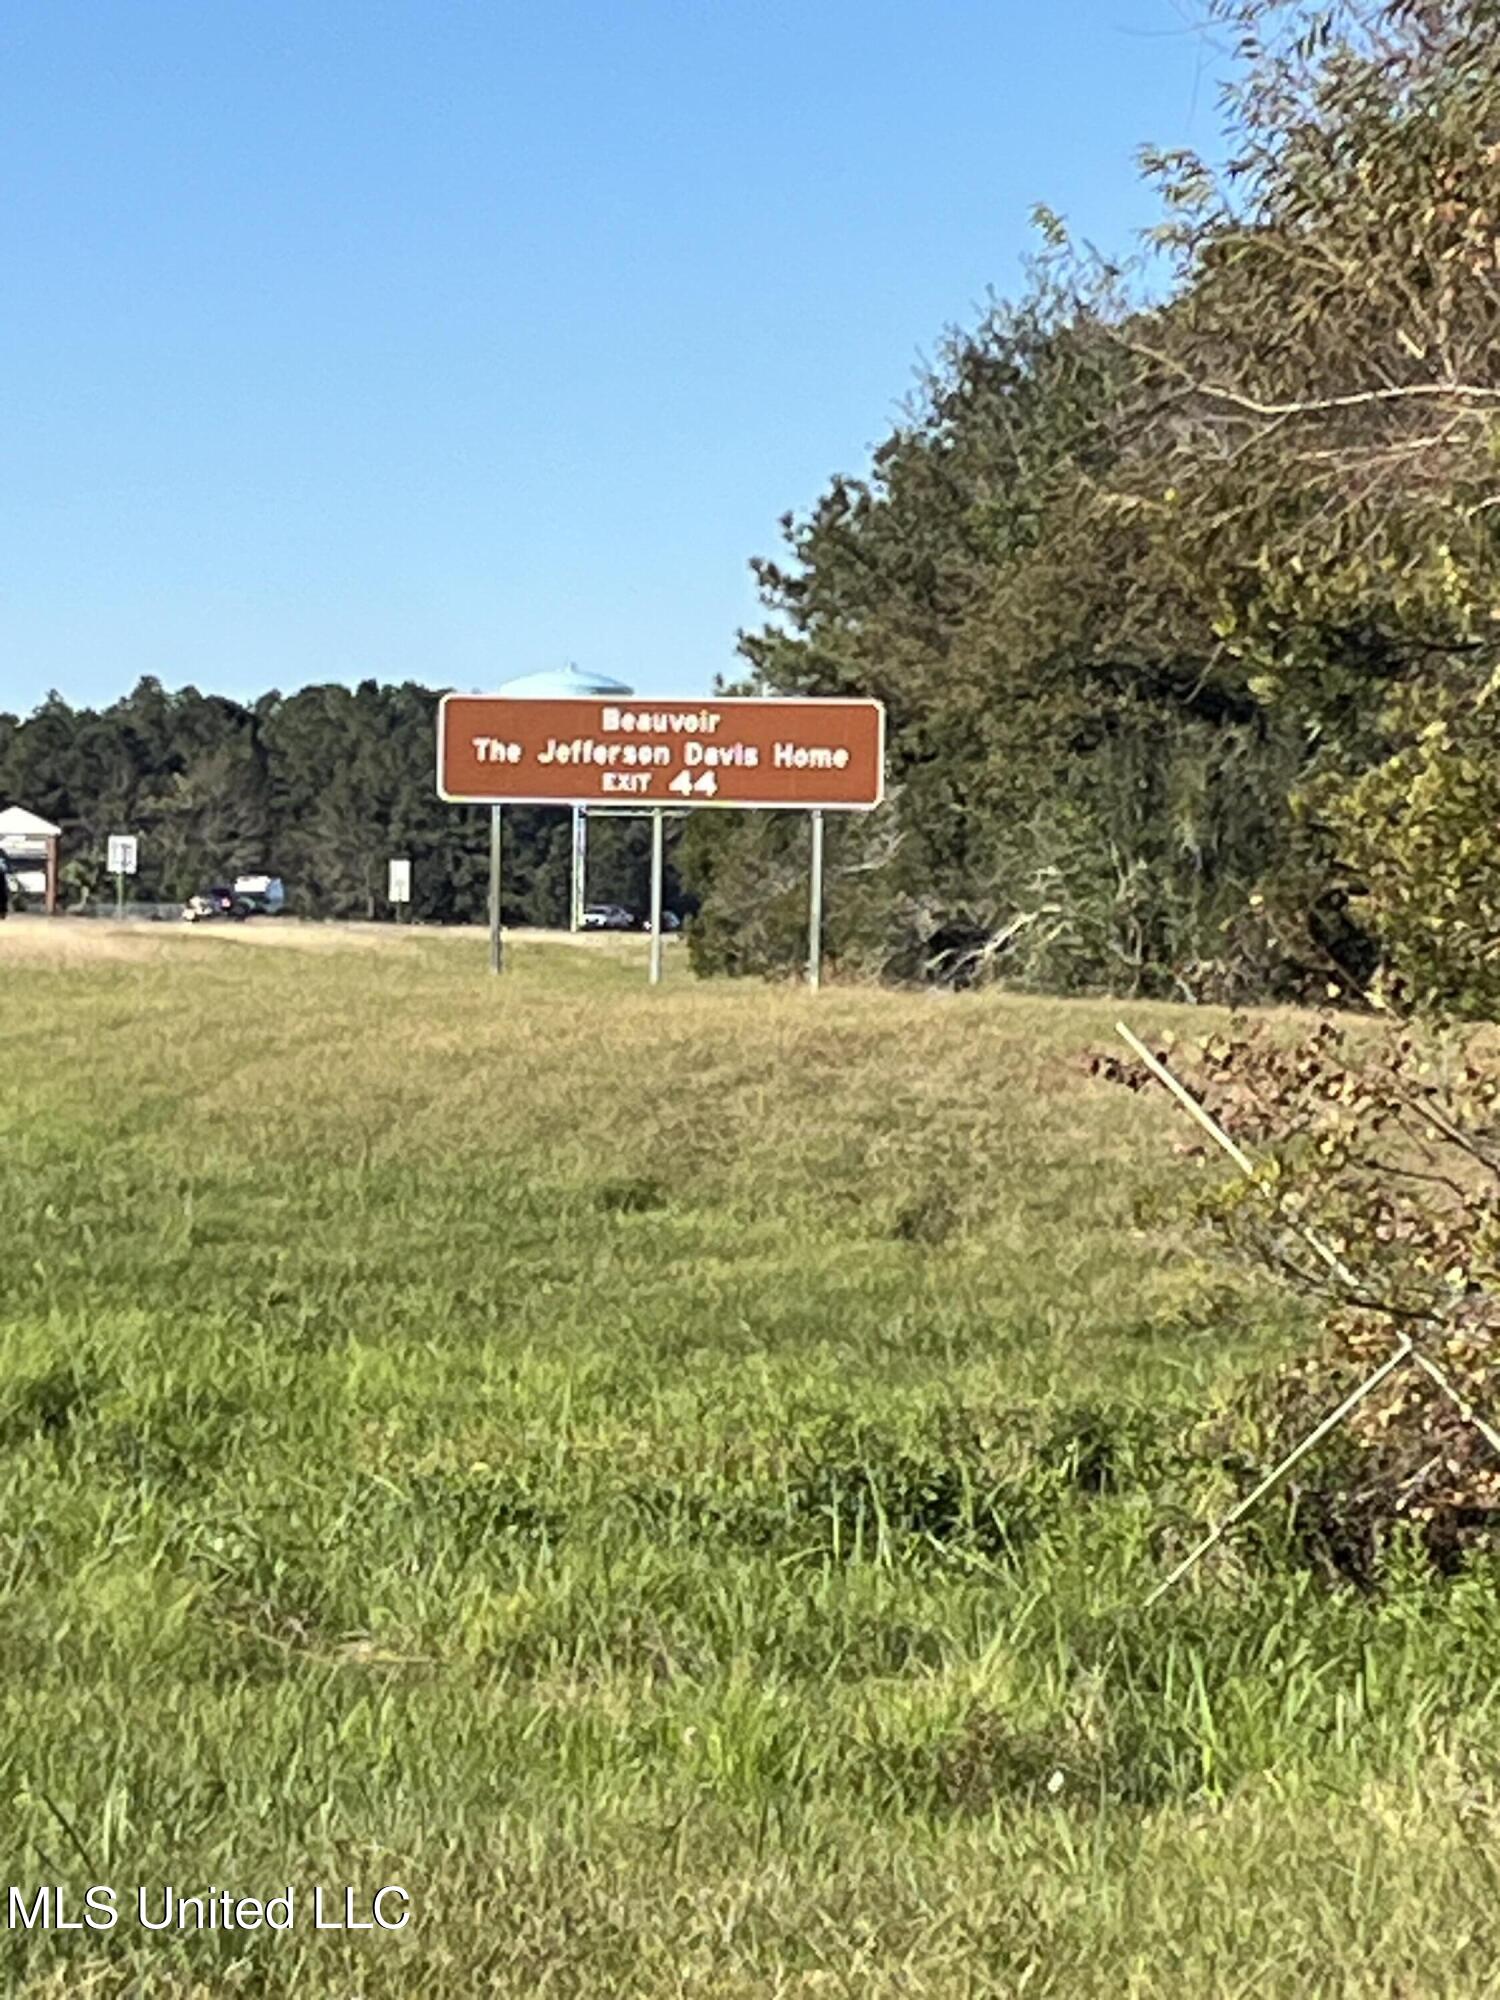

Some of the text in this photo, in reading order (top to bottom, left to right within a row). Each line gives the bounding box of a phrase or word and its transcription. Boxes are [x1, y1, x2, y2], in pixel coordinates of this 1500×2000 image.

[602, 707, 721, 732] Beauvoir
[472, 738, 849, 769] The Jefferson Davis Home
[602, 769, 718, 797] EXIT 44
